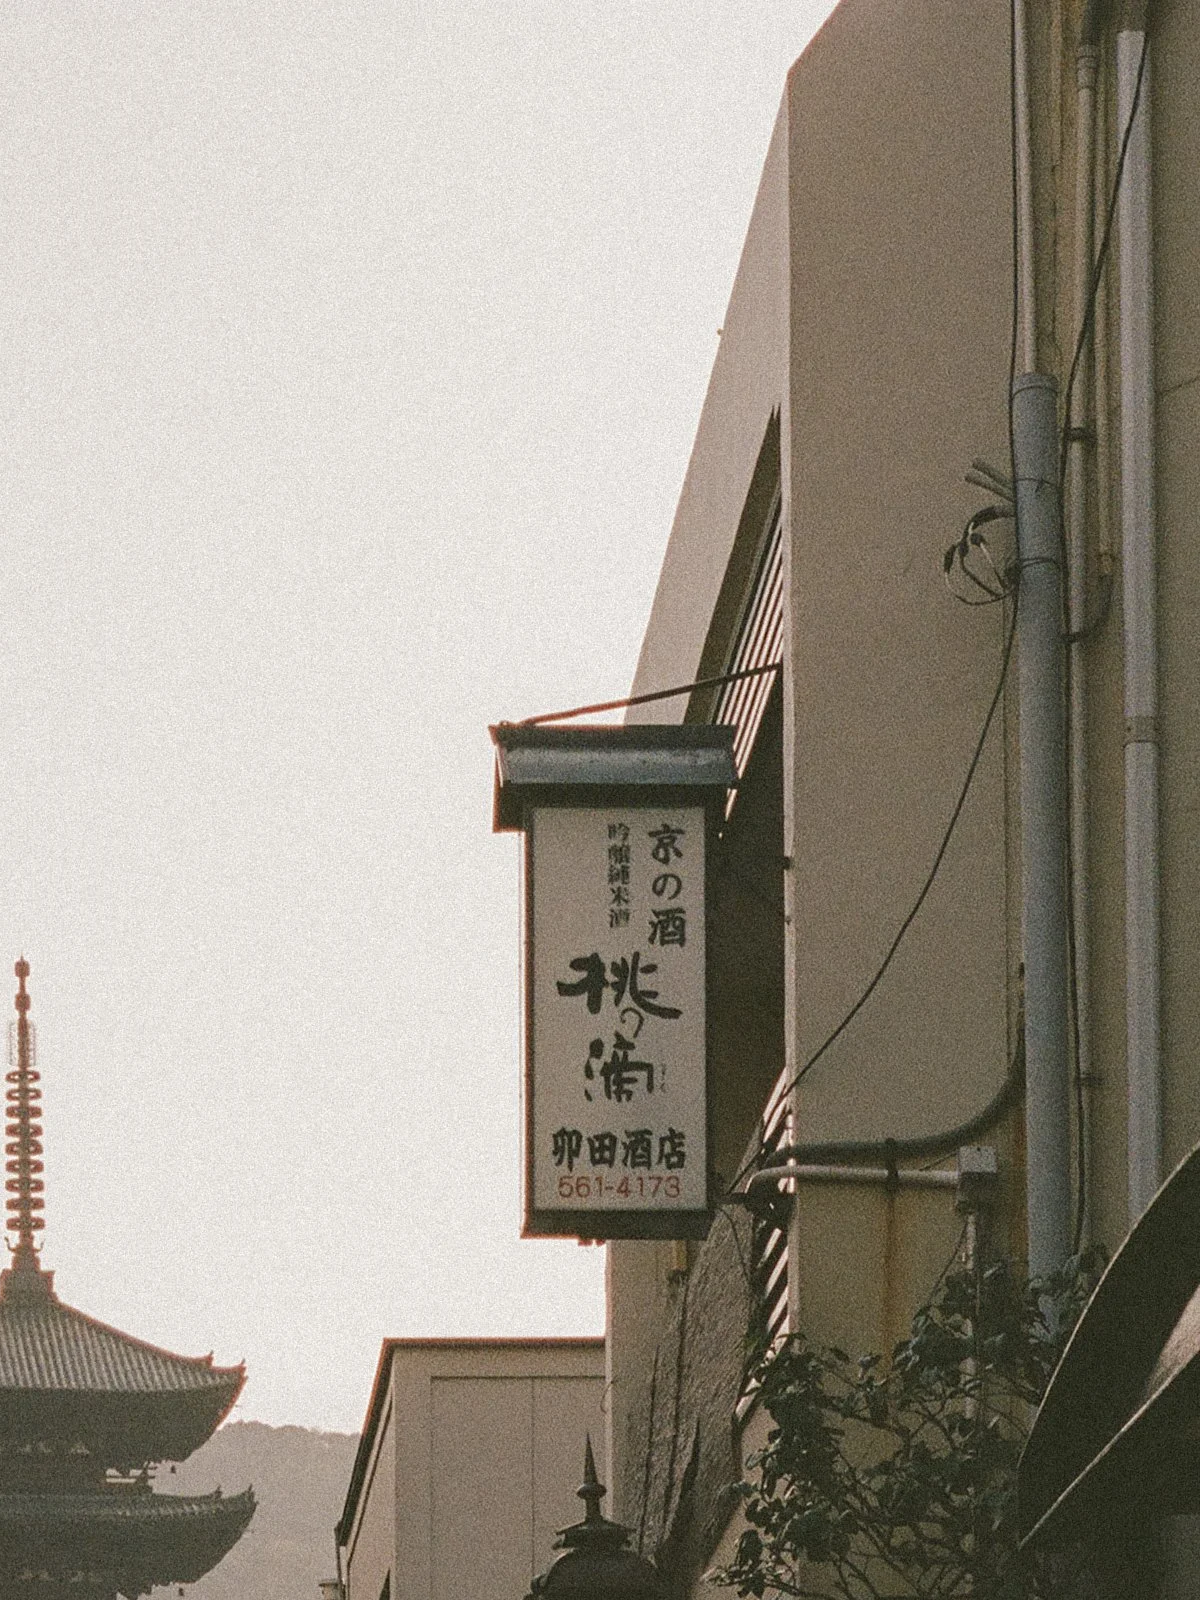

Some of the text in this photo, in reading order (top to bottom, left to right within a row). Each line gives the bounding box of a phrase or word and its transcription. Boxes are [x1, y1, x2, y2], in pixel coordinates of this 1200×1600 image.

[648, 823, 687, 949] 京の酒
[557, 950, 683, 1103] 桃の滴
[557, 1175, 681, 1199] 561-4173
